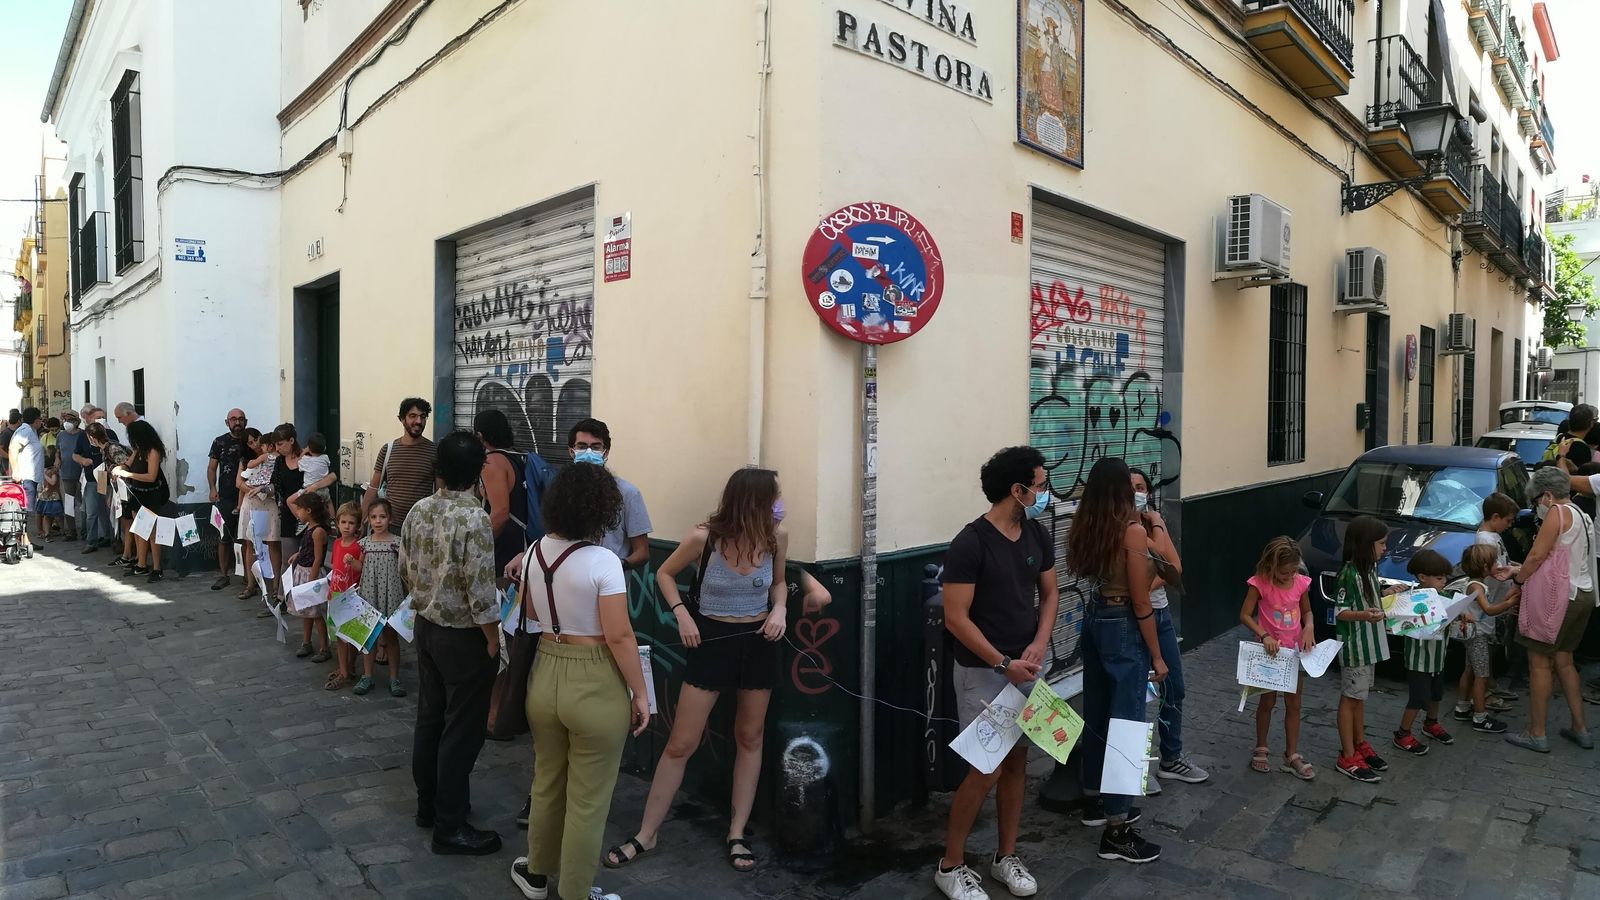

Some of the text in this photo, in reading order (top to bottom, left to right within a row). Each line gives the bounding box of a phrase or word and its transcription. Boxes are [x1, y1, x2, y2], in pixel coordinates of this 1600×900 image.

[836, 10, 993, 100] PASTORA
[606, 242, 629, 253] Alarma
[1056, 326, 1115, 348] COLECTIVO
